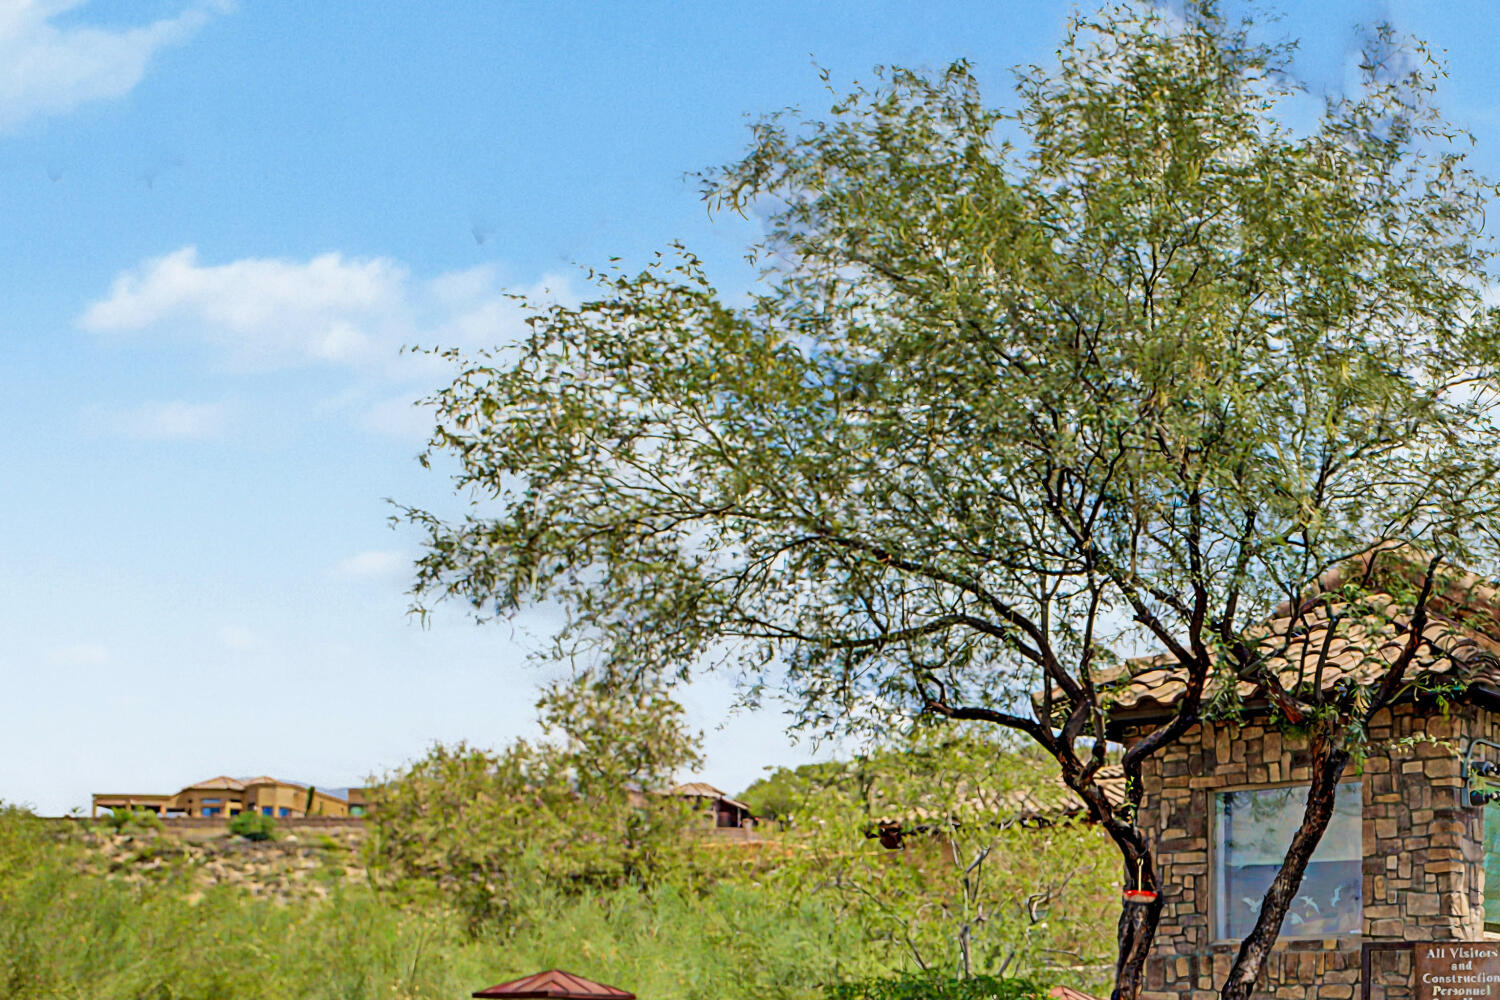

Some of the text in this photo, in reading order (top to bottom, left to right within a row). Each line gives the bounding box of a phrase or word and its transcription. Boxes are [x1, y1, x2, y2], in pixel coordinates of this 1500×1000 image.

[1426, 947, 1498, 959] All Visitors
[1451, 960, 1473, 971] and
[1422, 971, 1500, 984] Construction
[1432, 984, 1492, 996] Personnel
